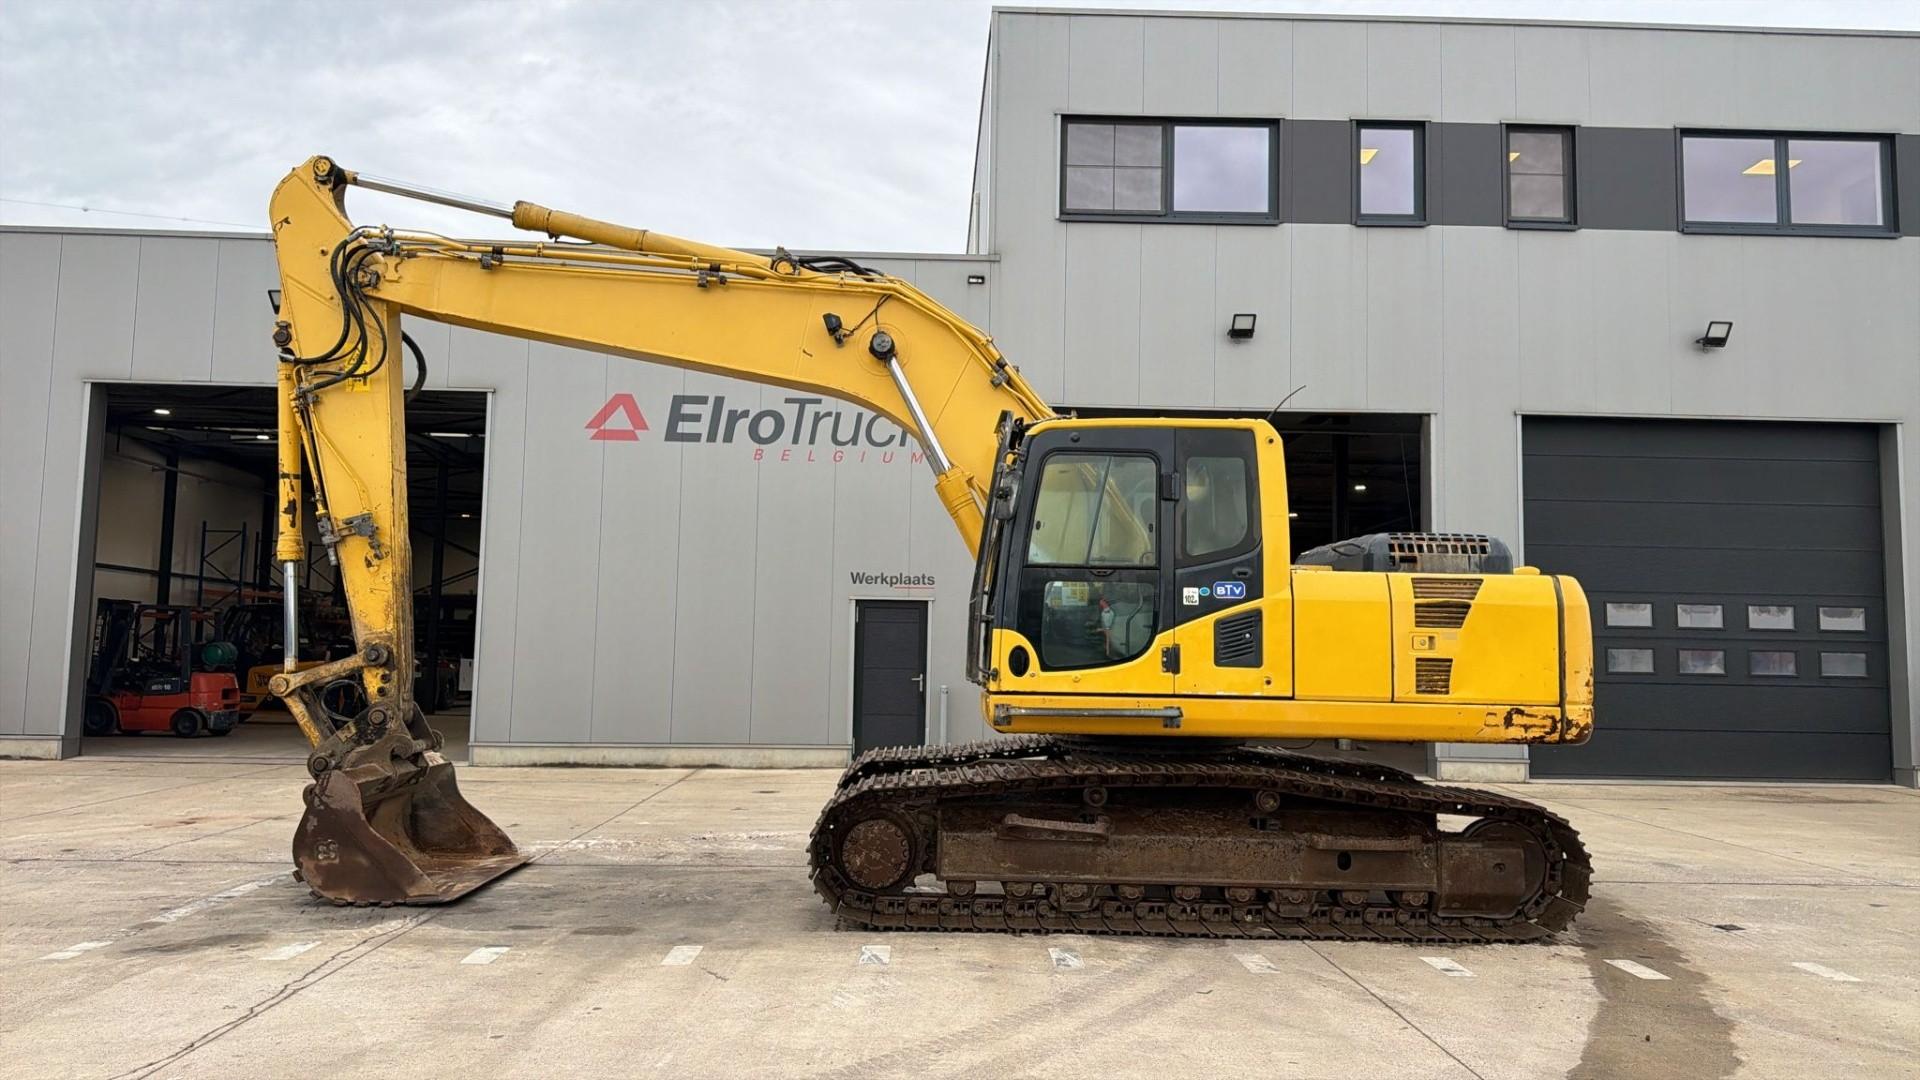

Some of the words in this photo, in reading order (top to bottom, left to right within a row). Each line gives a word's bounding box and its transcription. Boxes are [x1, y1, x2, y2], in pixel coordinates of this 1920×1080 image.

[753, 449, 925, 464] BELGIUM
[850, 571, 936, 588] Werkplaats
[1216, 584, 1242, 595] BTV
